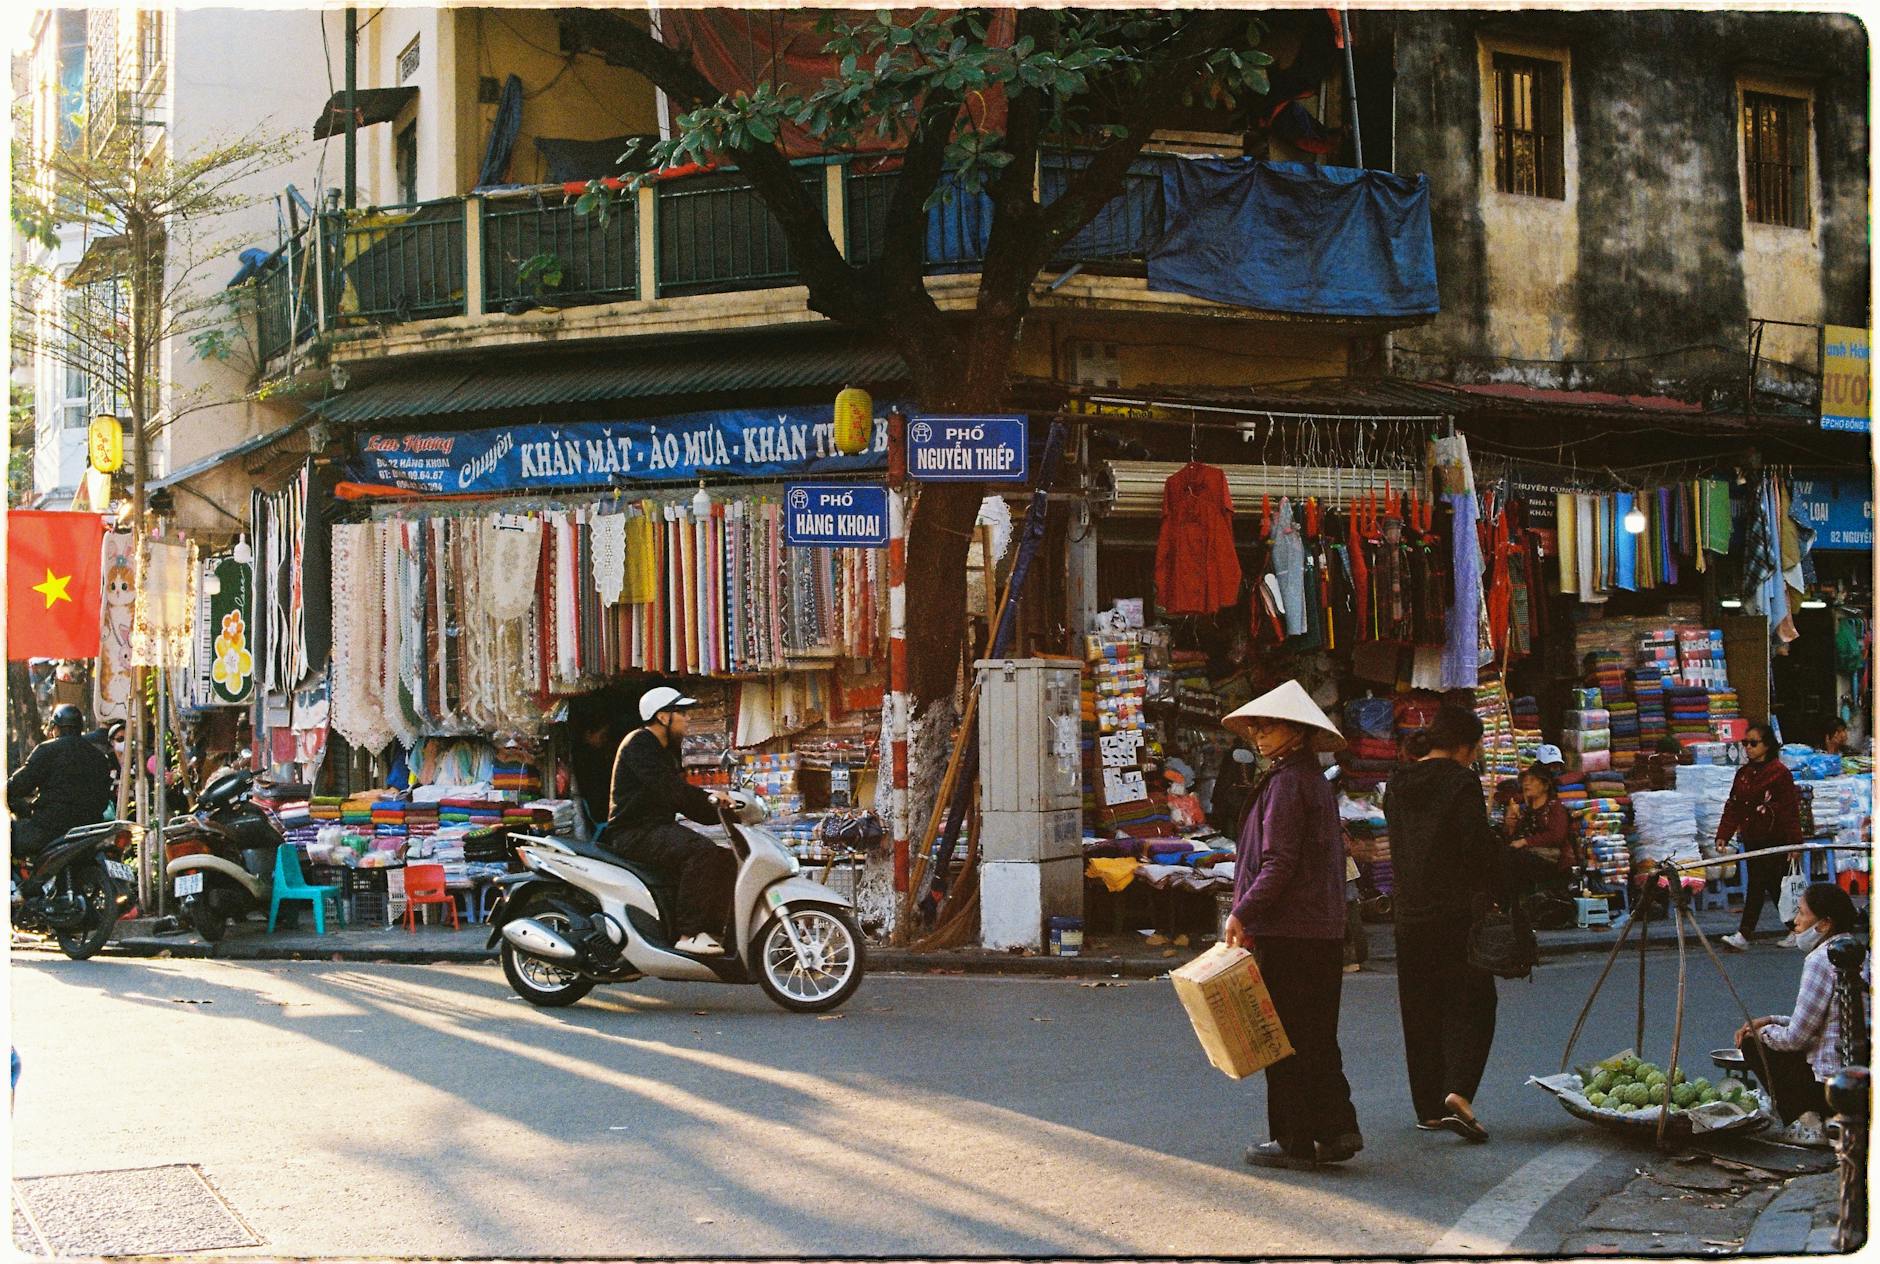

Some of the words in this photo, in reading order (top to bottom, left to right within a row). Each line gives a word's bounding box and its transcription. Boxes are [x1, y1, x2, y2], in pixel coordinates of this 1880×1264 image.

[521, 430, 582, 478] KHĂN
[683, 423, 730, 466] MƯA
[742, 414, 808, 464] KHĂN
[945, 423, 985, 441] PHỐ
[917, 441, 972, 470] NGUYỄN
[975, 442, 1015, 470] THIẾP
[820, 490, 854, 507] PHỐ
[796, 509, 834, 536] HÀNG
[837, 514, 880, 537] KHOAI
